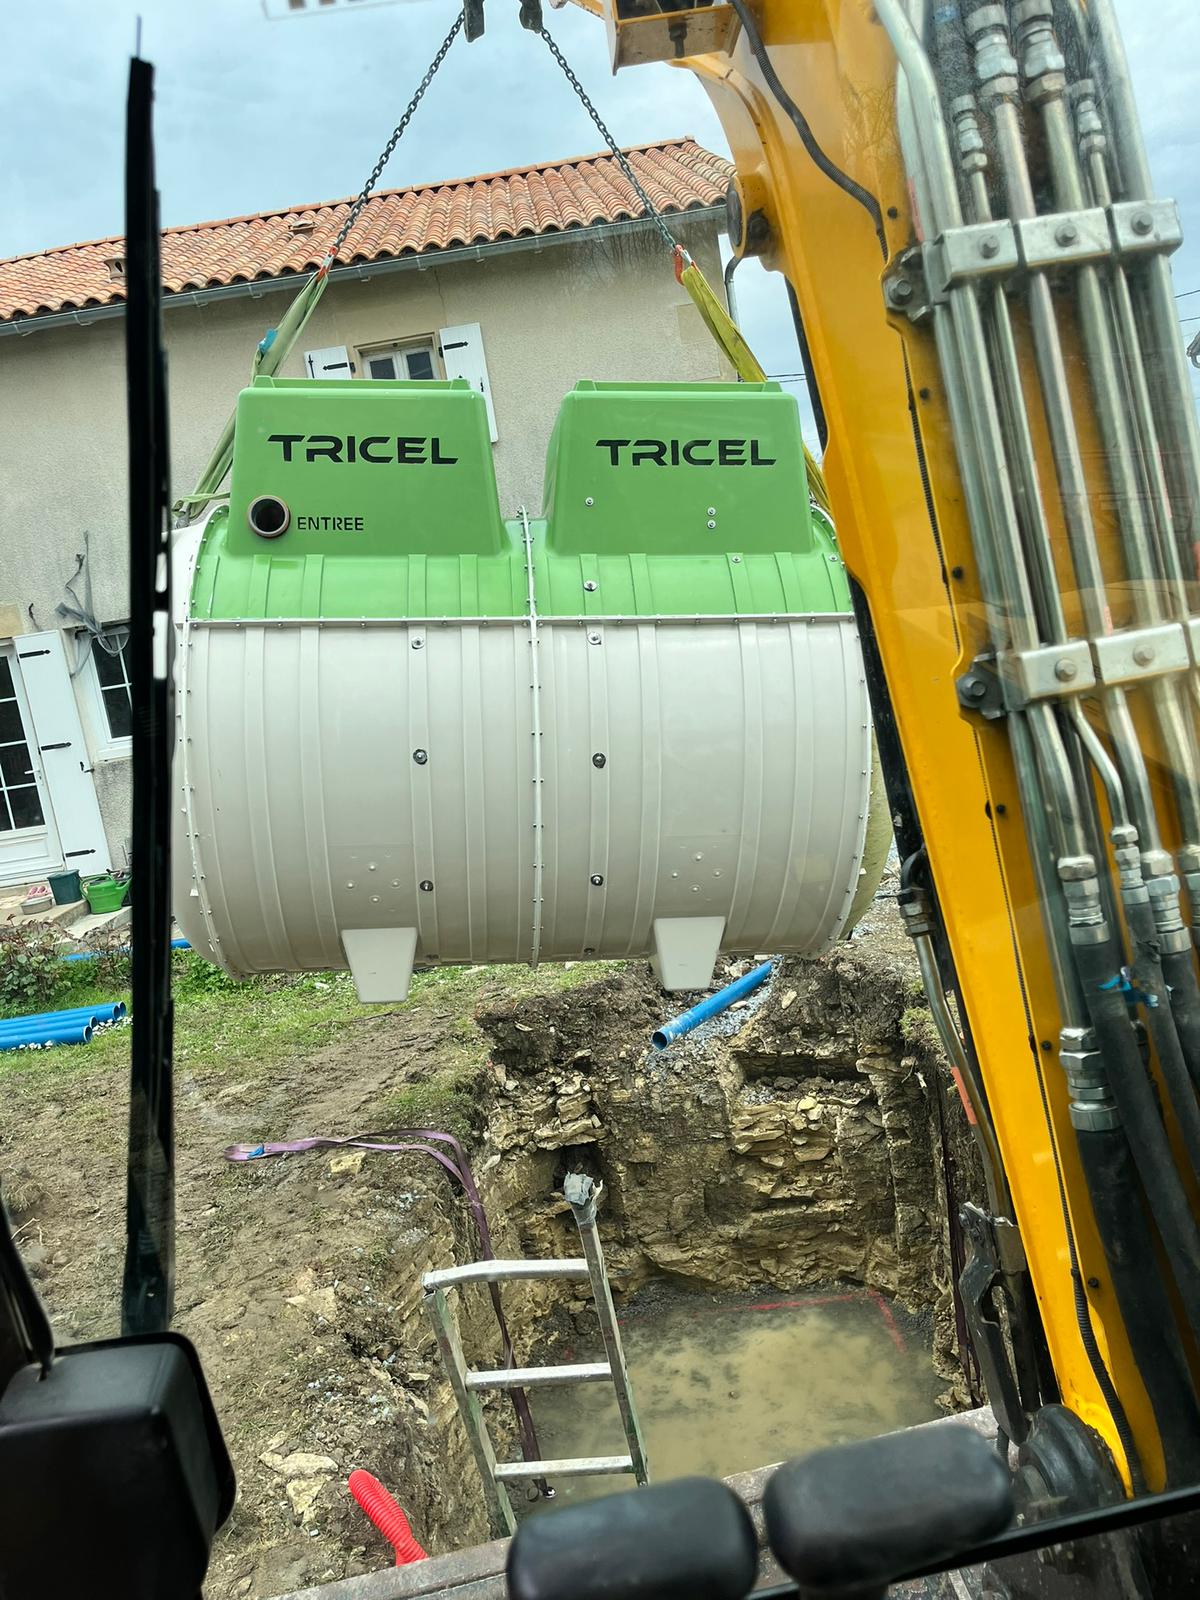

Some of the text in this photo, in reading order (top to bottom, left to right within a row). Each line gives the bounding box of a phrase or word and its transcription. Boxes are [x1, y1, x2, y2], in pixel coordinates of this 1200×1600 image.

[267, 434, 459, 465] TRICEL
[595, 439, 777, 467] TRICEL
[297, 516, 364, 531] ENTREE
